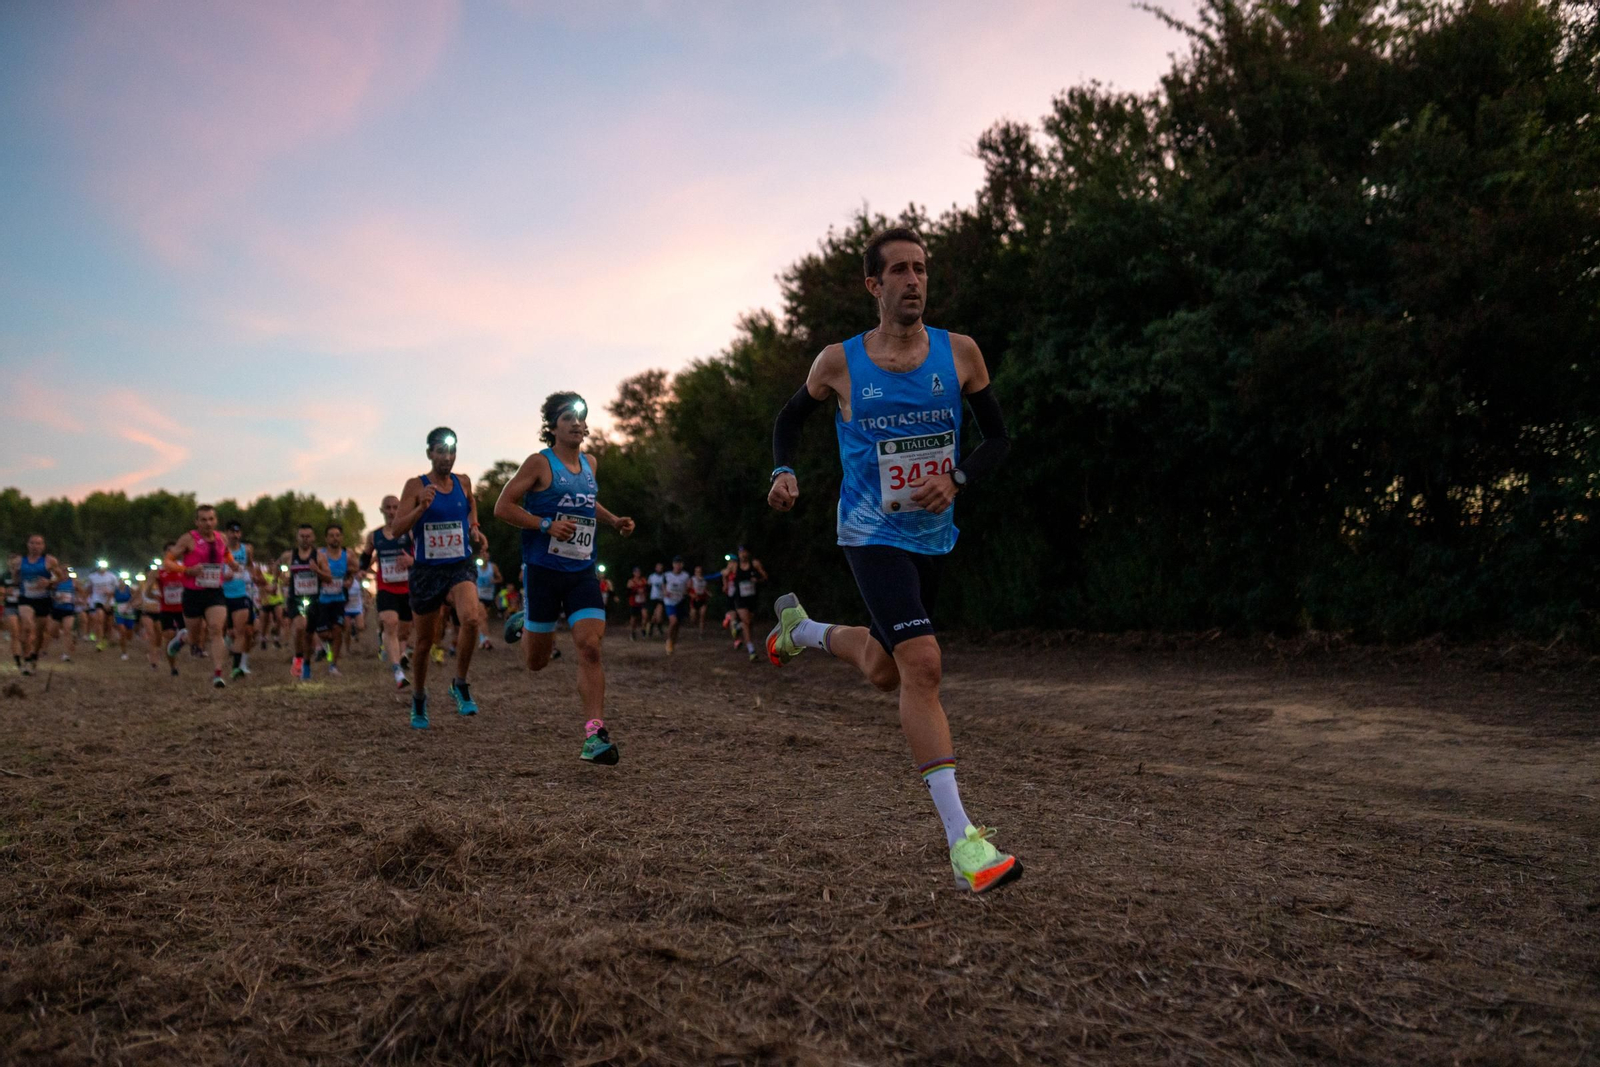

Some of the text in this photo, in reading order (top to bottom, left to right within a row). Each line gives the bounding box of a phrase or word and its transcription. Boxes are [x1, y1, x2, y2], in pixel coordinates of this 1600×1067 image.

[901, 438, 940, 451] ITÁLICA
[429, 534, 462, 548] 3173
[556, 529, 592, 547] 240
